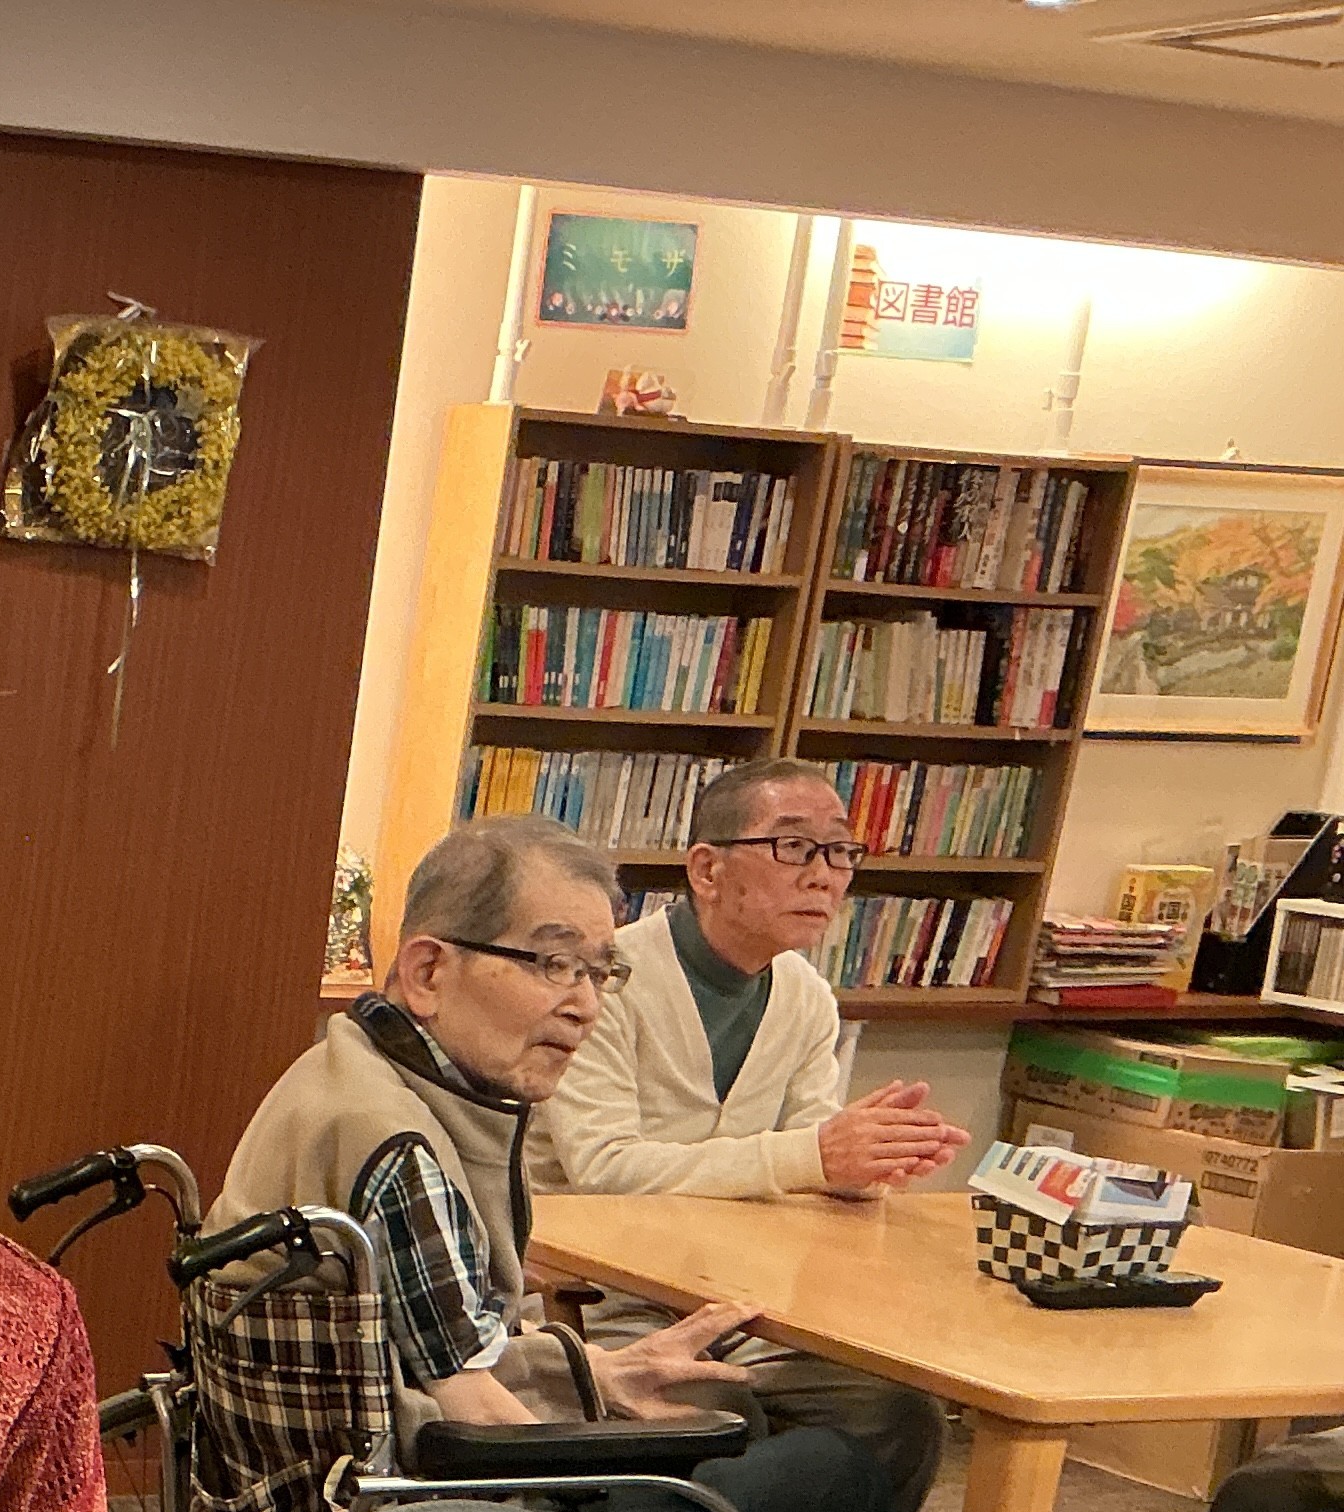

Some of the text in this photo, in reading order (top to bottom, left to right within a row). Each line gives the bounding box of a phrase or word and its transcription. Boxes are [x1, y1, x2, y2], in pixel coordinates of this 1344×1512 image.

[562, 242, 685, 277] ミモザ
[875, 280, 980, 329] 図書館
